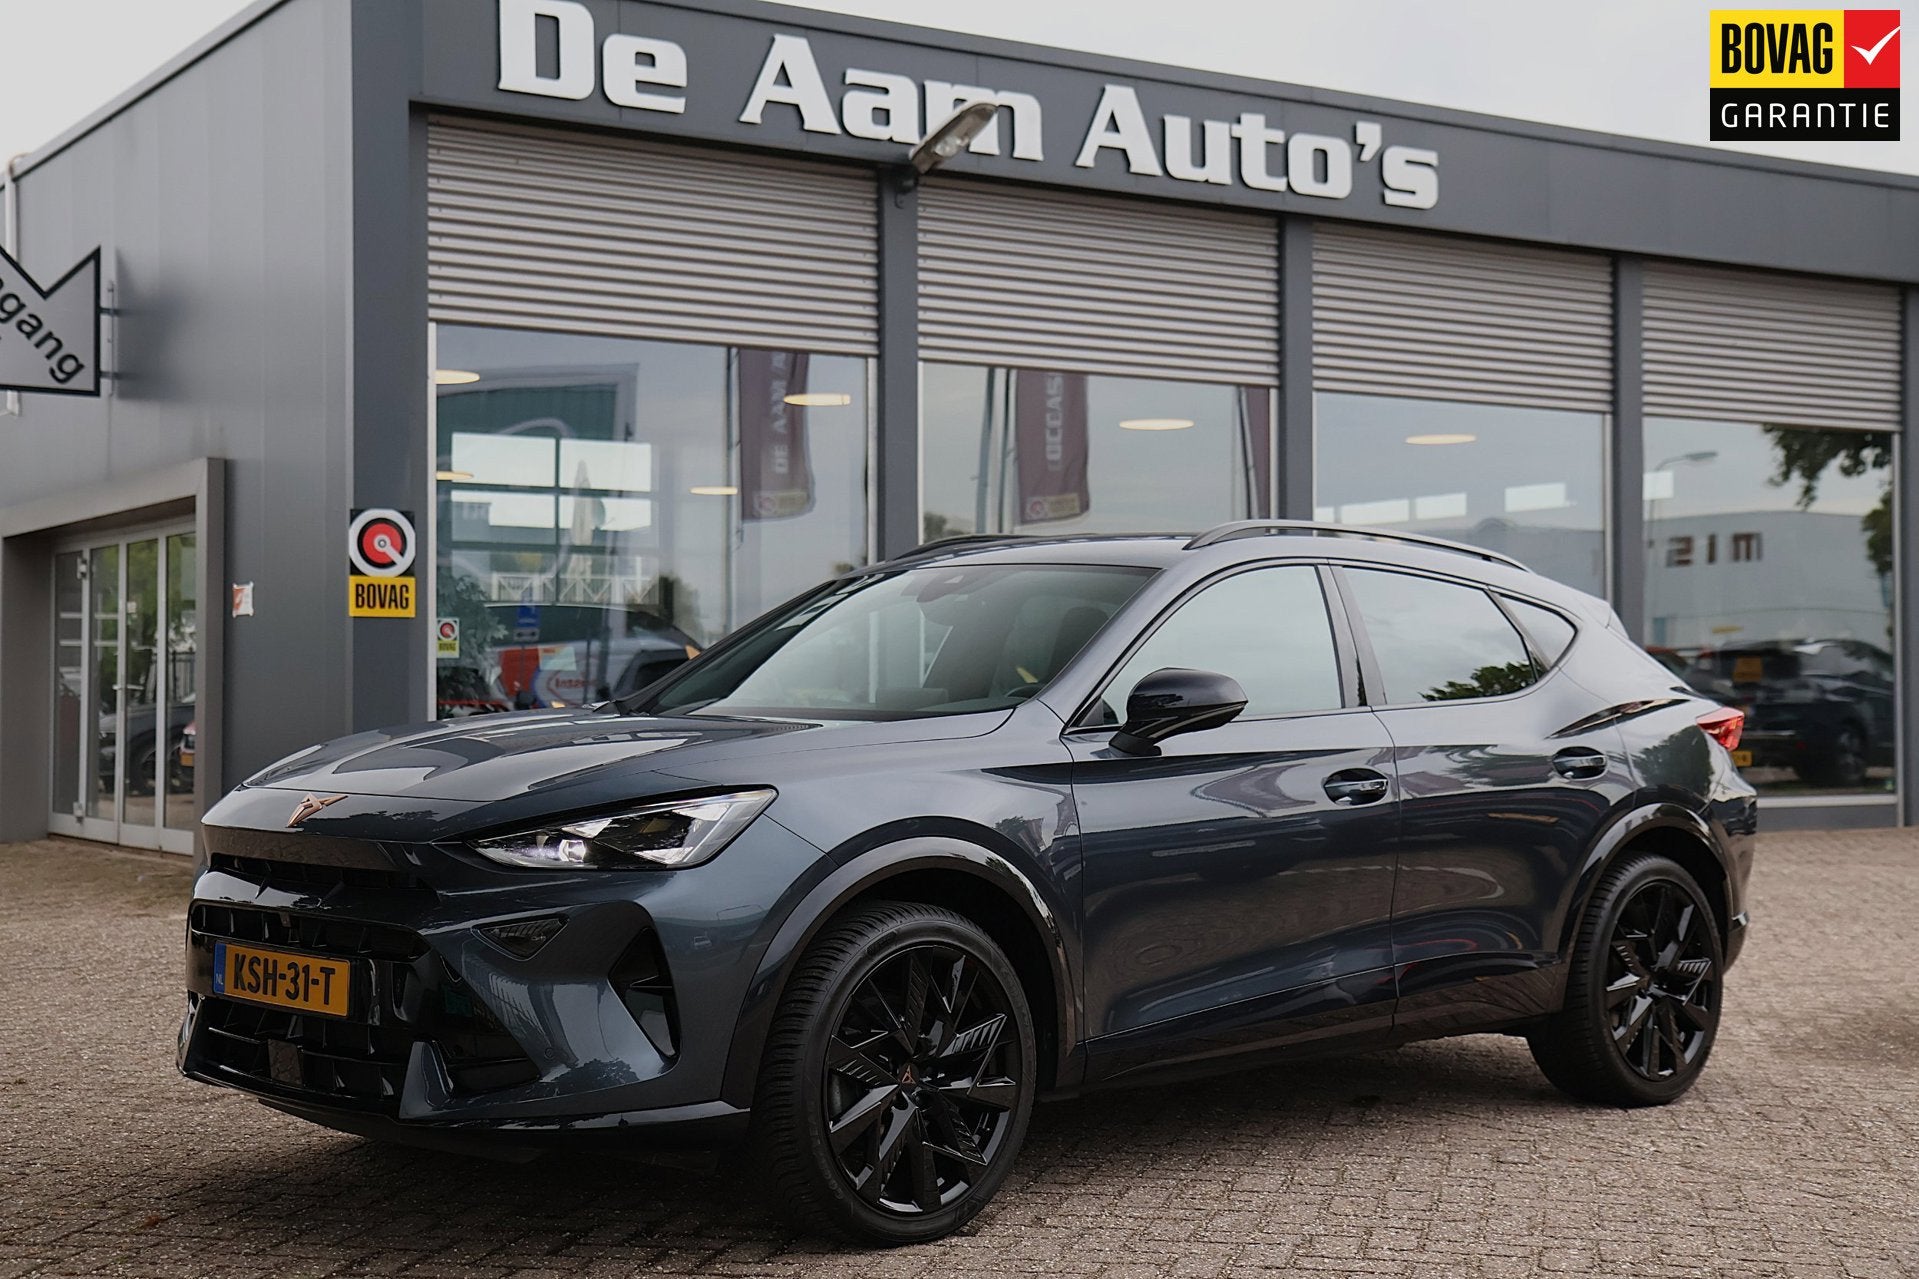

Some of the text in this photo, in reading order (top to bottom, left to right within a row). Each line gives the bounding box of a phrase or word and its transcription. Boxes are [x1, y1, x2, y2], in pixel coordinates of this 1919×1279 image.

[497, 0, 1440, 210] De Aam Auto's
[0, 278, 85, 384] gang
[1045, 373, 1064, 461] OCCAS
[355, 583, 410, 610] BOVAG
[233, 953, 336, 1006] KSH-31-T
